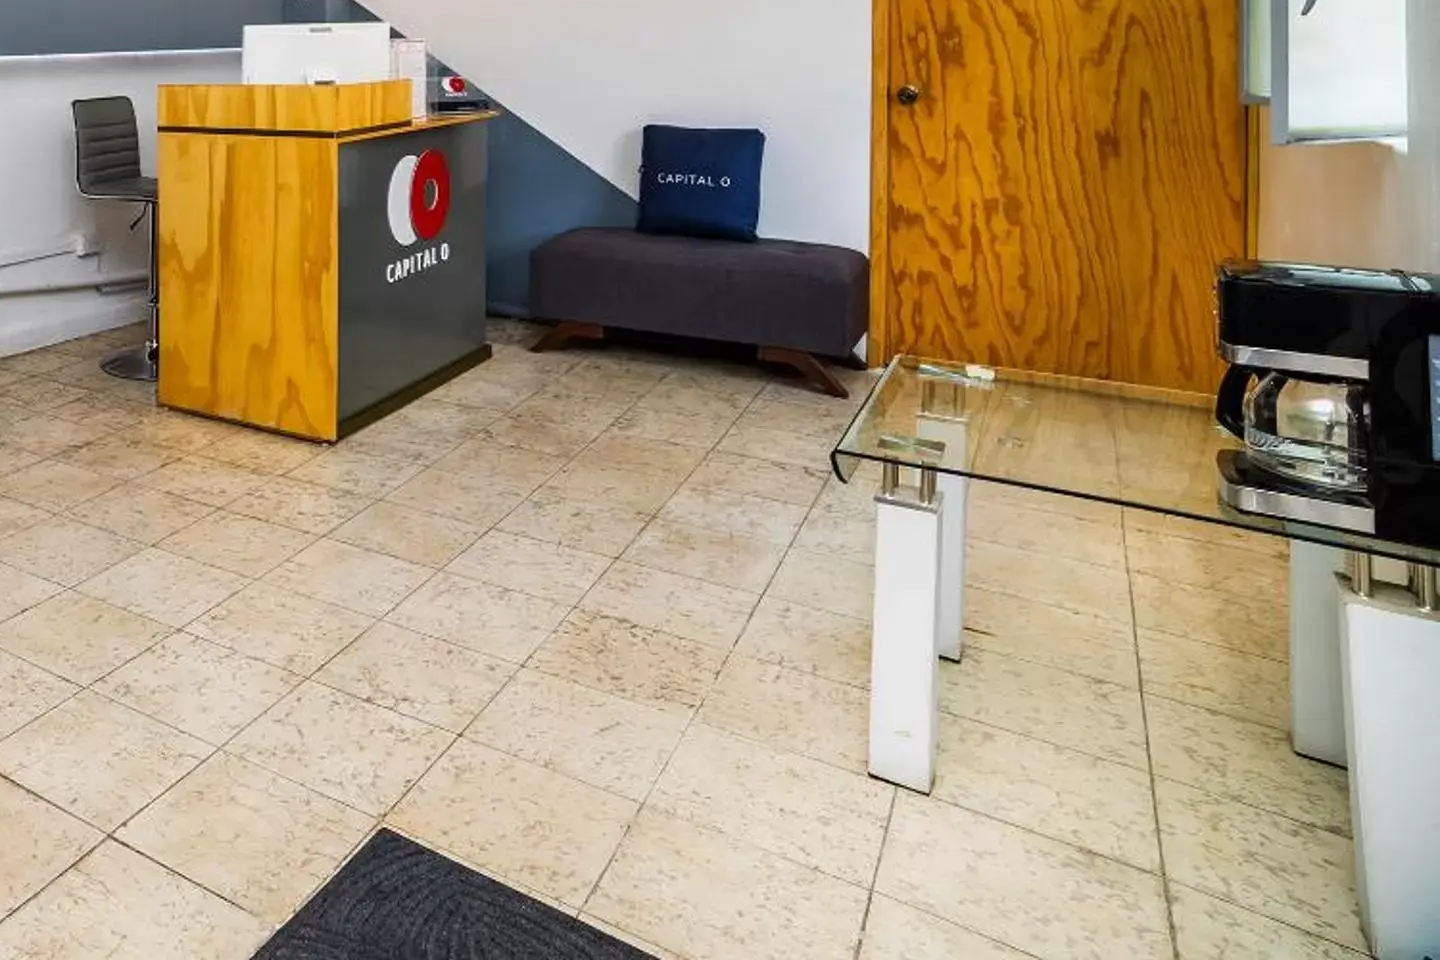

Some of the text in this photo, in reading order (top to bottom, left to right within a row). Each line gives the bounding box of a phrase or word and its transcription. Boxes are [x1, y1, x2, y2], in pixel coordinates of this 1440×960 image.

[657, 172, 731, 187] CAPITAL O
[386, 243, 450, 283] CAPITAL O
